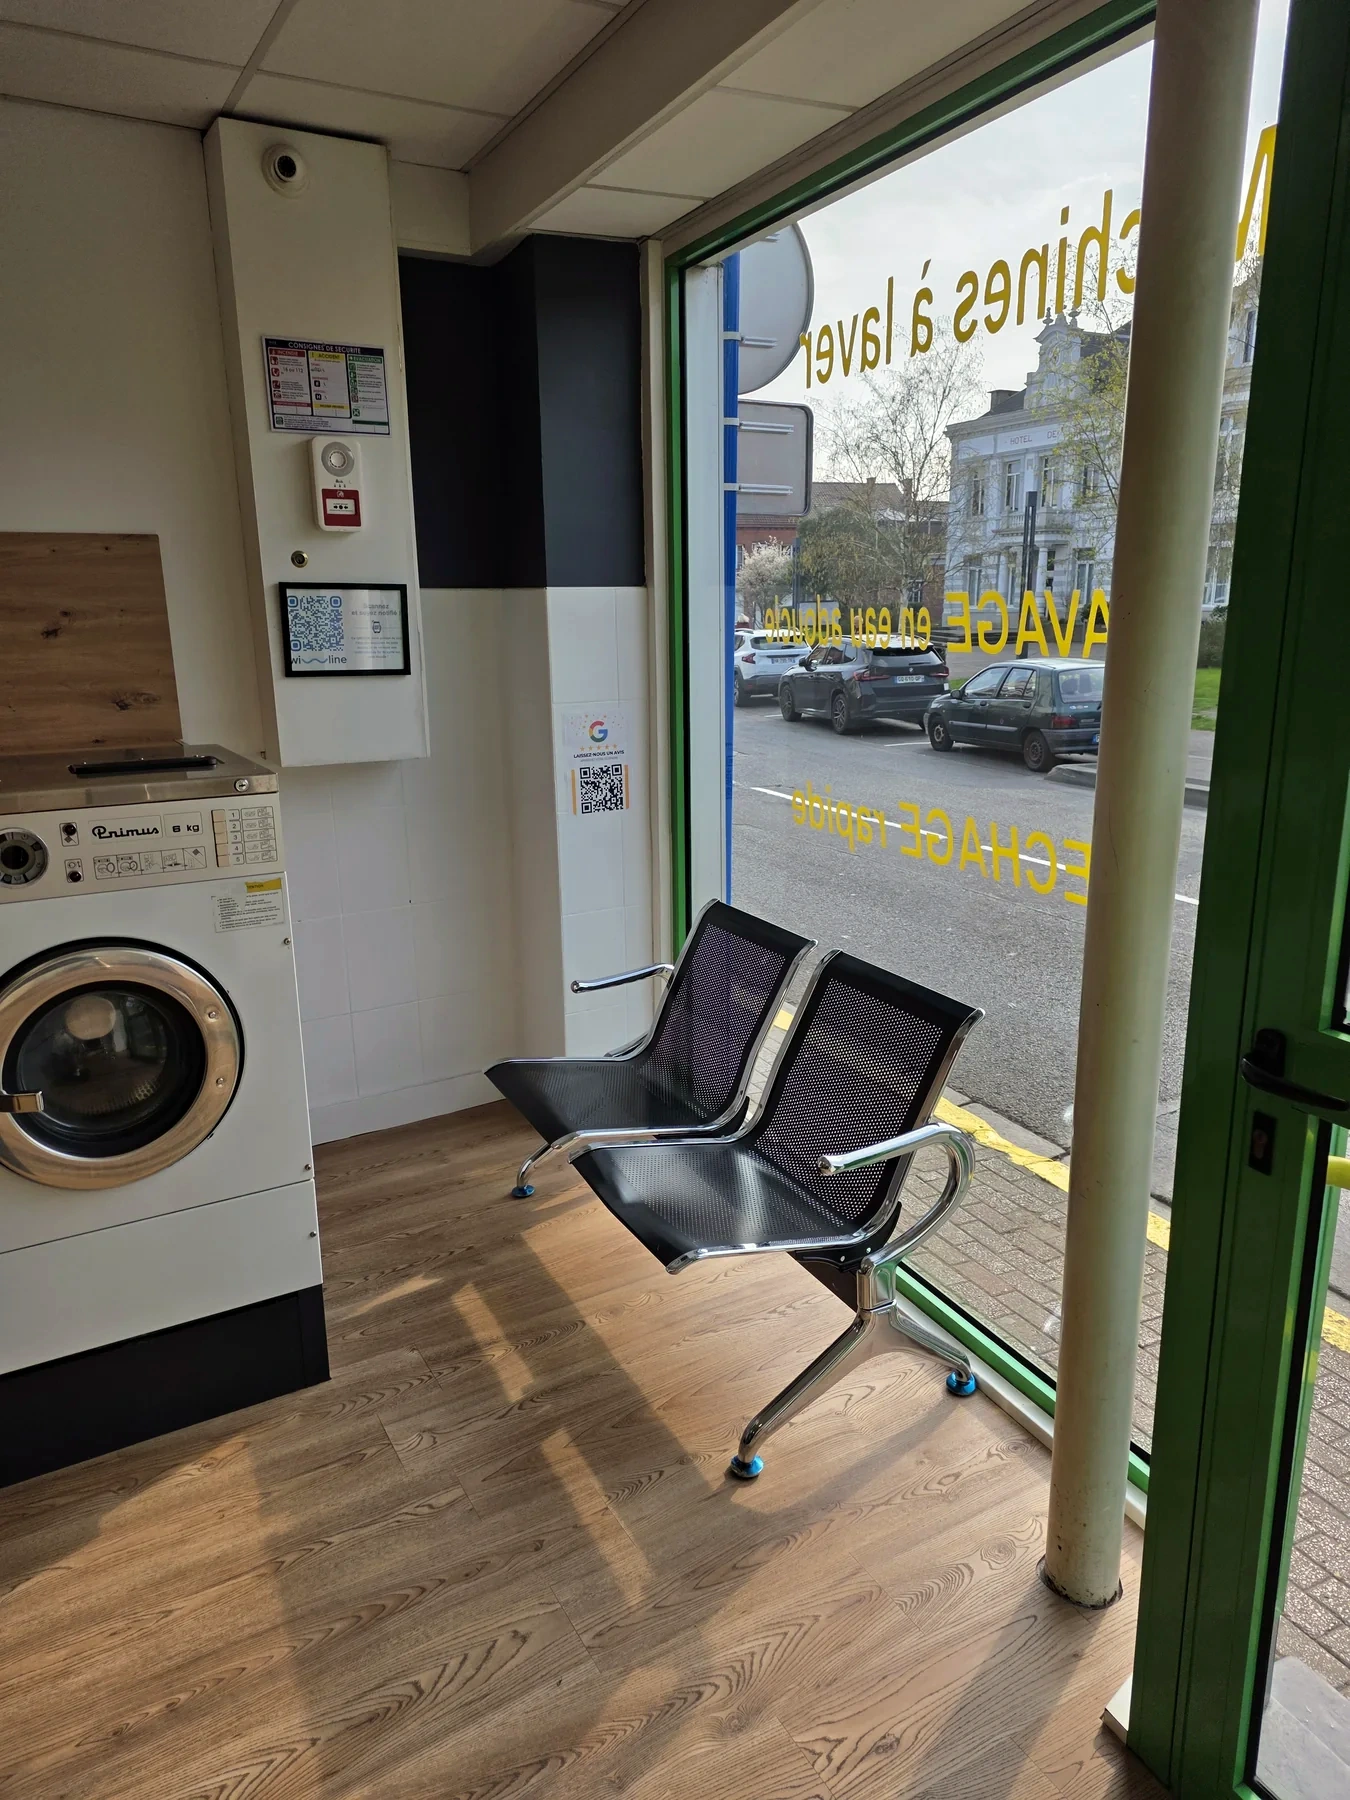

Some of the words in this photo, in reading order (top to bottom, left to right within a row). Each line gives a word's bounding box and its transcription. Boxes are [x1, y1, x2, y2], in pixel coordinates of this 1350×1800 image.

[287, 341, 325, 351] CONSIGNES
[1010, 435, 1033, 445] HOTEL
[328, 655, 347, 664] line
[92, 825, 159, 840] Primus
[186, 824, 200, 833] kg
